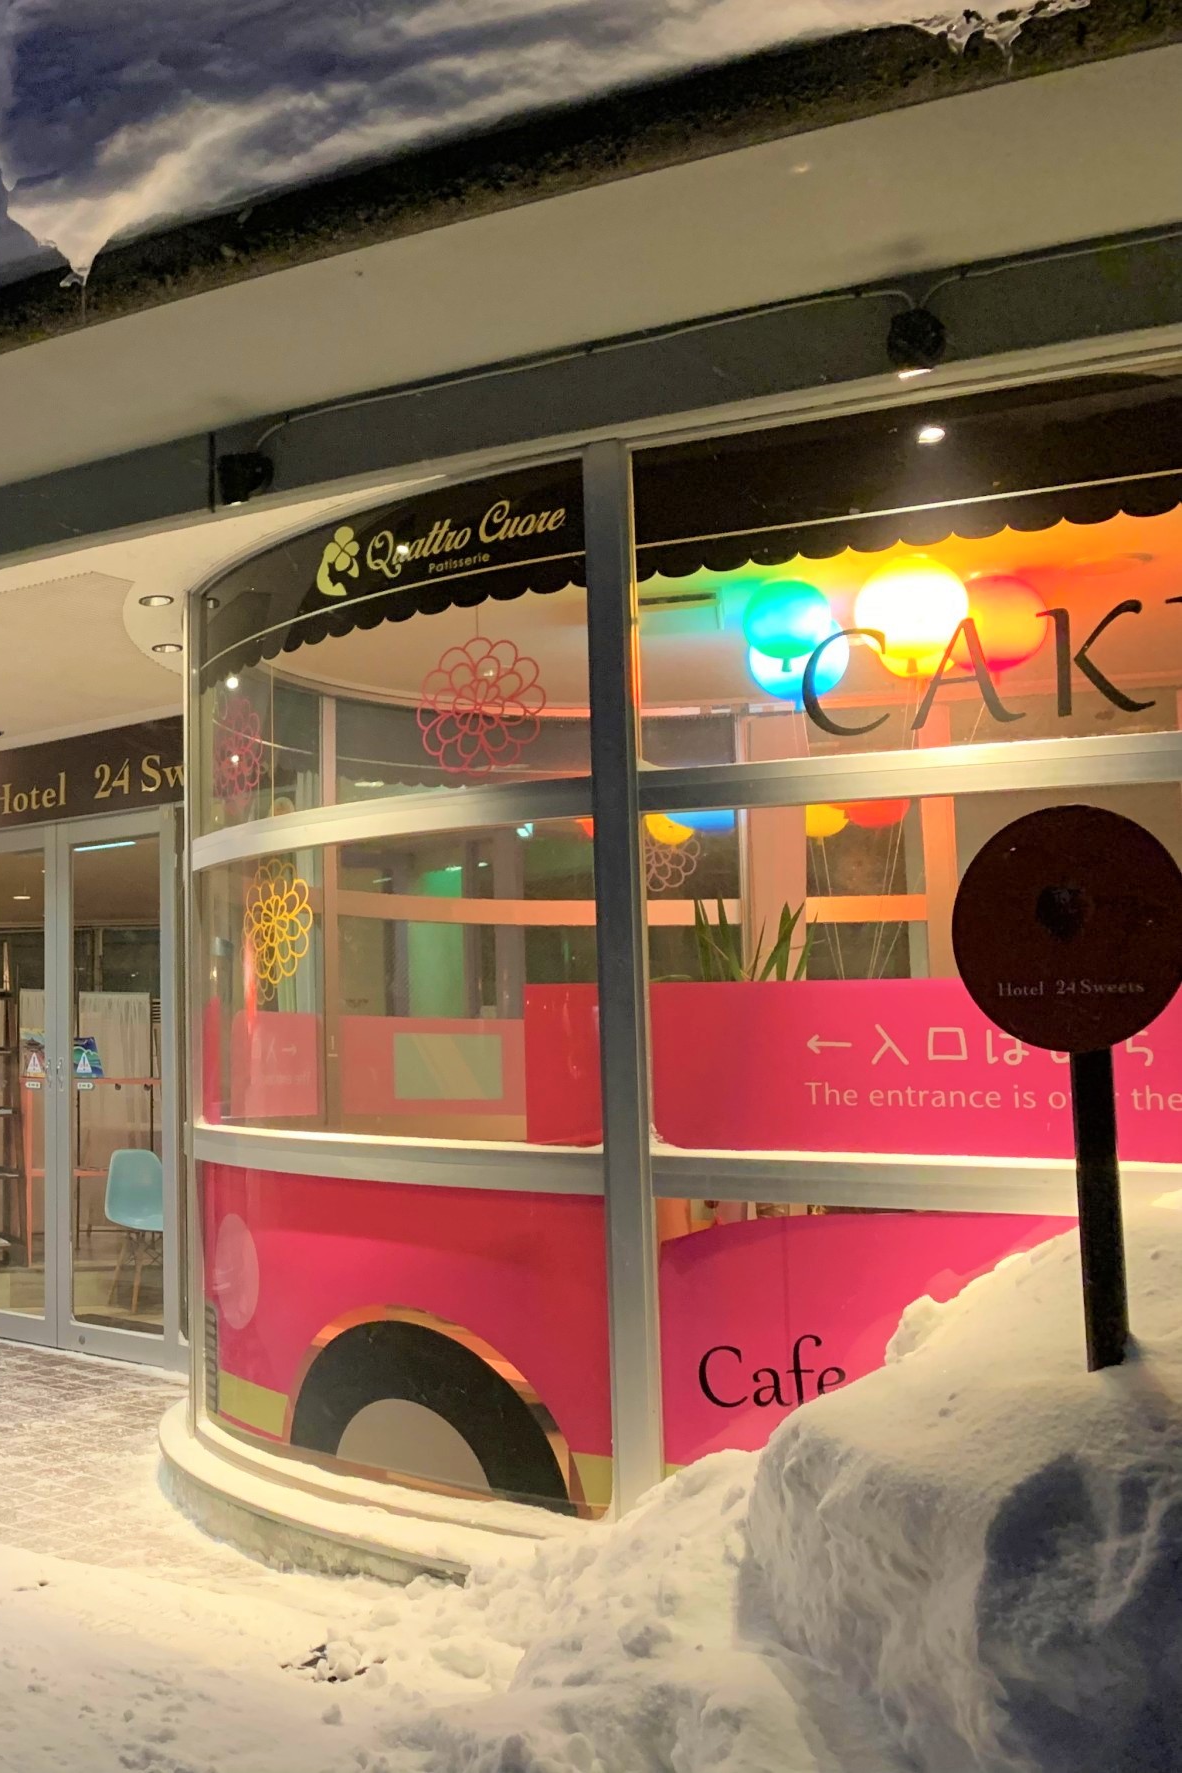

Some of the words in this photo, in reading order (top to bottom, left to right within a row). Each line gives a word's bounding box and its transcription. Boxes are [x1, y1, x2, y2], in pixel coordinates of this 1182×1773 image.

[366, 518, 472, 579] Quattro
[479, 499, 566, 544] Cuore
[428, 551, 491, 574] Patisserie
[94, 758, 131, 800] 24
[997, 981, 1044, 997] Hotel
[1055, 979, 1076, 996] 24
[1079, 978, 1145, 996] Sweets
[805, 1081, 858, 1107] The
[869, 1085, 1002, 1109] entrance
[1014, 1085, 1036, 1110] is
[698, 1334, 846, 1409] Cafe
